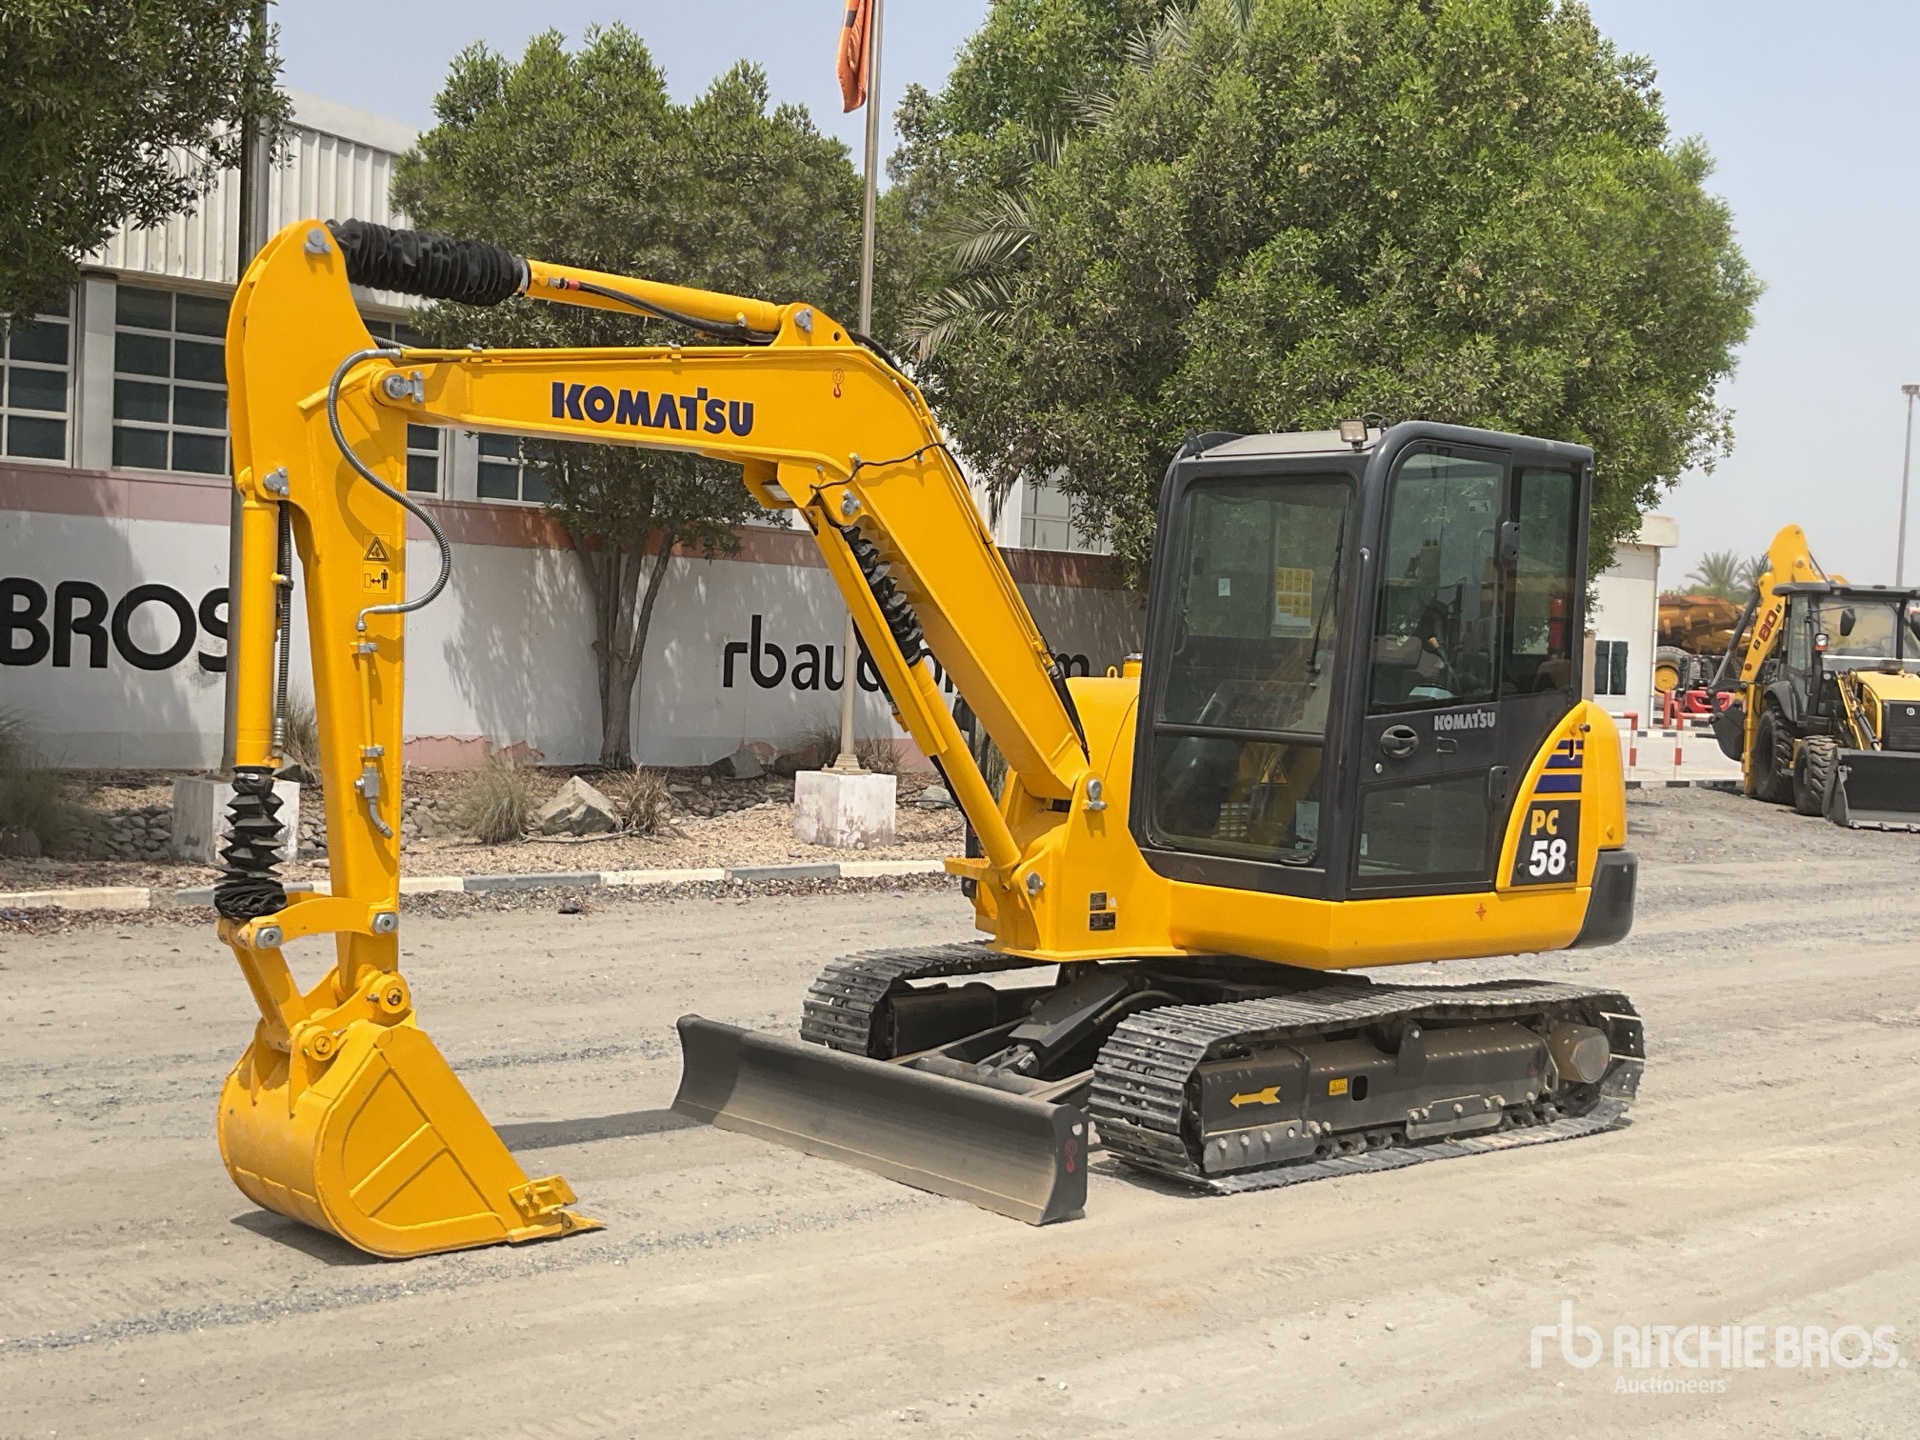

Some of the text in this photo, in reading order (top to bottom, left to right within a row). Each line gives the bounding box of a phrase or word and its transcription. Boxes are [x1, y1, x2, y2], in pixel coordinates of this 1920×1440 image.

[551, 381, 754, 437] KOMATSU
[1434, 708, 1496, 731] KOMATSU
[1530, 809, 1559, 836] PC
[1528, 838, 1567, 877] 58
